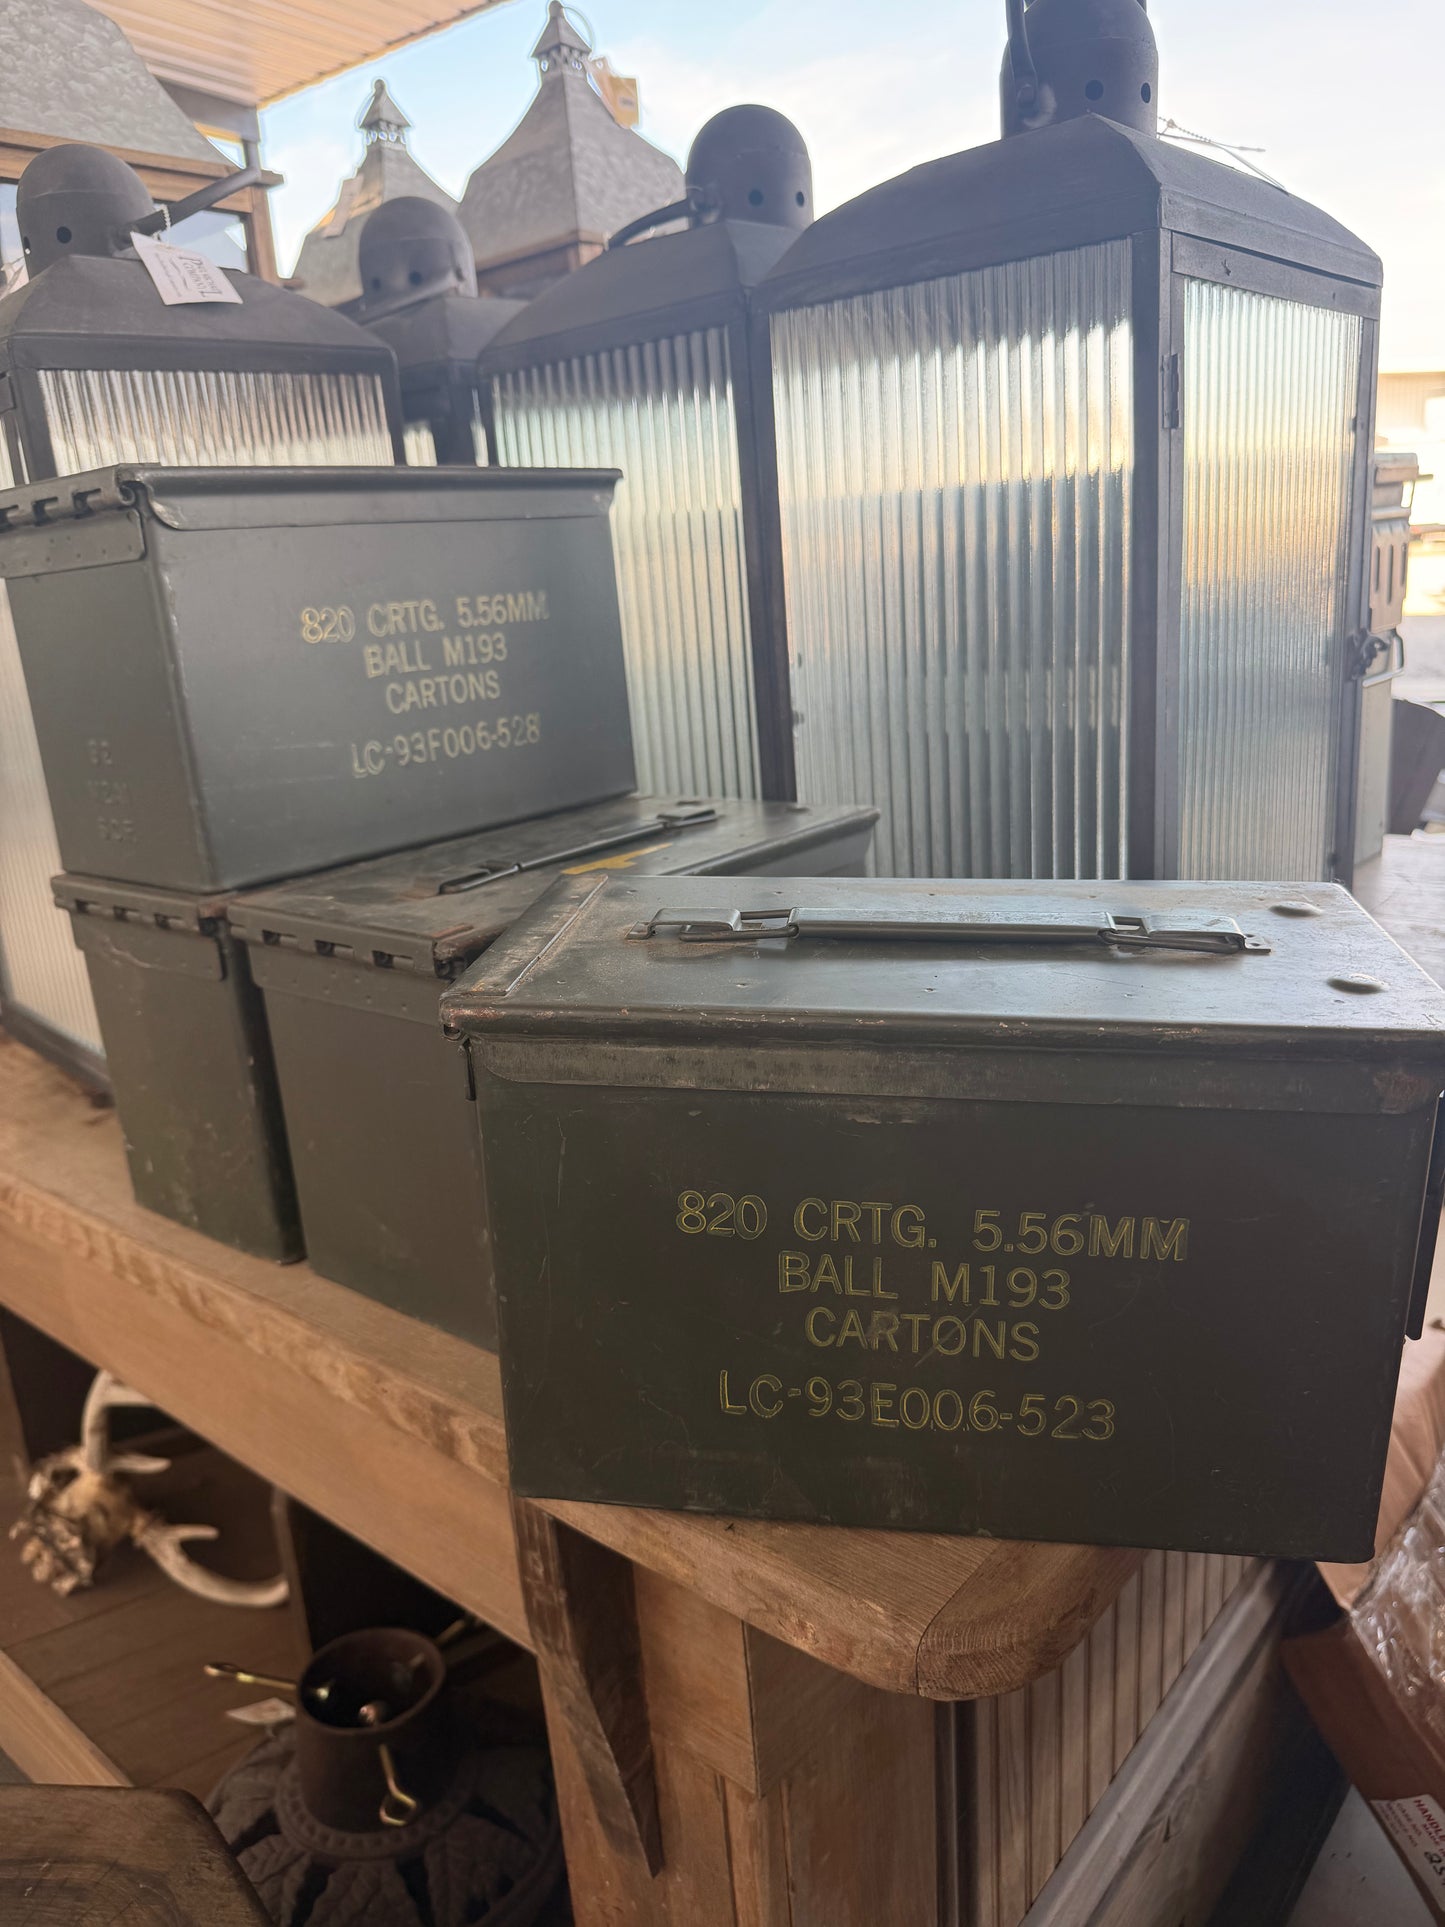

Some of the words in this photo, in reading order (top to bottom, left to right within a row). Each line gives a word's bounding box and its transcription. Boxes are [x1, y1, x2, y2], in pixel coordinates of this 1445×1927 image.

[301, 606, 356, 644] 820
[368, 599, 445, 637] CRTG.
[456, 590, 549, 629] 5.56MM
[363, 644, 431, 679] BALL
[442, 631, 508, 668] M193
[386, 669, 501, 714] CARTONS
[352, 713, 541, 778] LC-93F006-528
[676, 1190, 768, 1240] 820
[793, 1198, 937, 1248] CRTG.
[971, 1209, 1190, 1261] 5.56MM
[778, 1250, 898, 1299] BALL
[931, 1261, 1071, 1310] M193
[805, 1307, 1040, 1361] CARTONS
[719, 1369, 1116, 1440] LC-93E006-523
